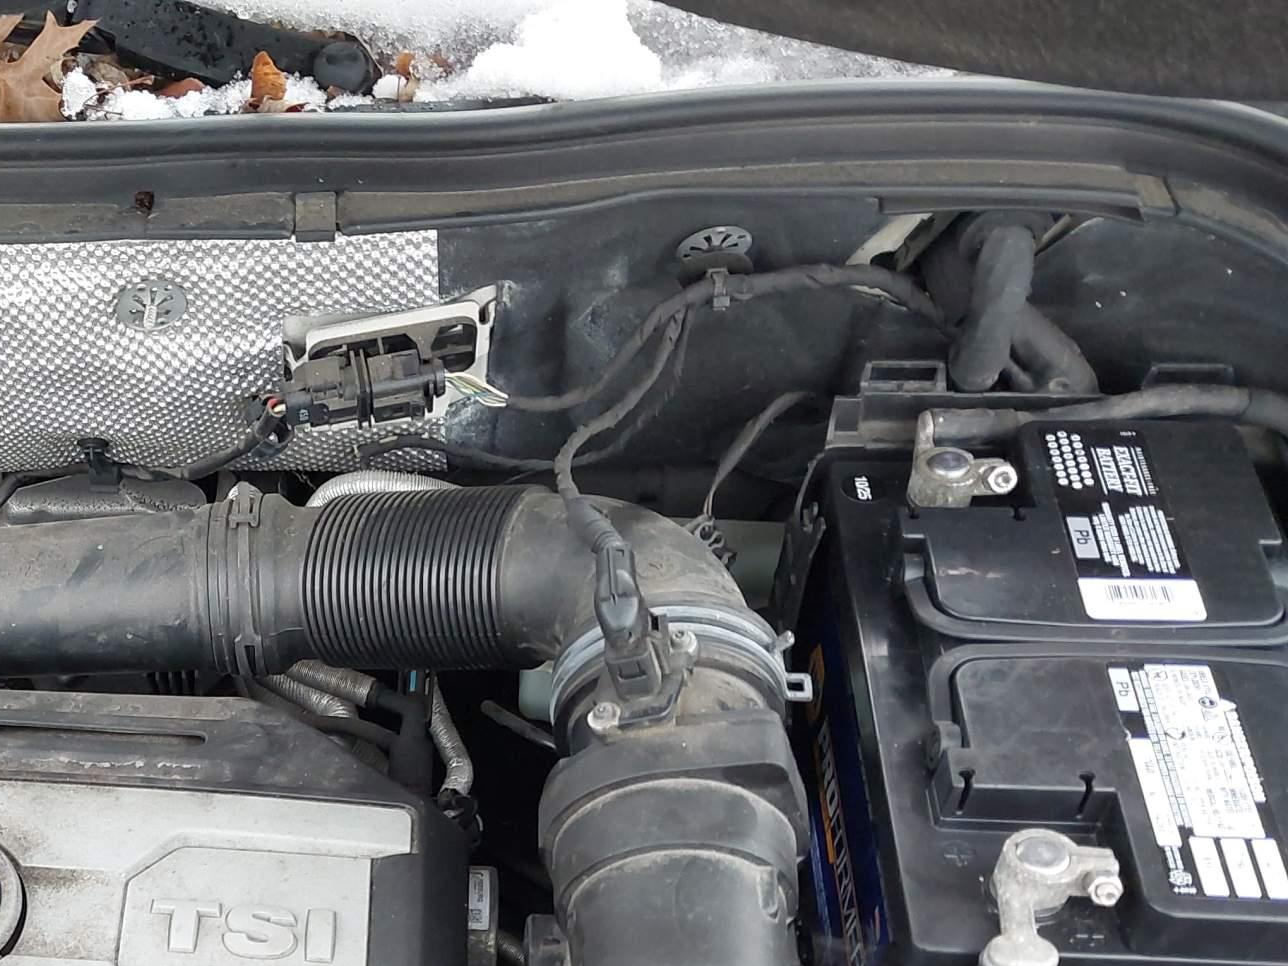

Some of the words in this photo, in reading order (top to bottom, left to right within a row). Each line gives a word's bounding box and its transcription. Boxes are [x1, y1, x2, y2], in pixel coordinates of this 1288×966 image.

[854, 475, 872, 500] 10/25
[1095, 447, 1124, 493] BATTERY
[1112, 445, 1143, 497] EXACT-FIT
[1074, 529, 1089, 545] Pb
[1116, 680, 1130, 697] Pb
[149, 898, 338, 964] TSI
